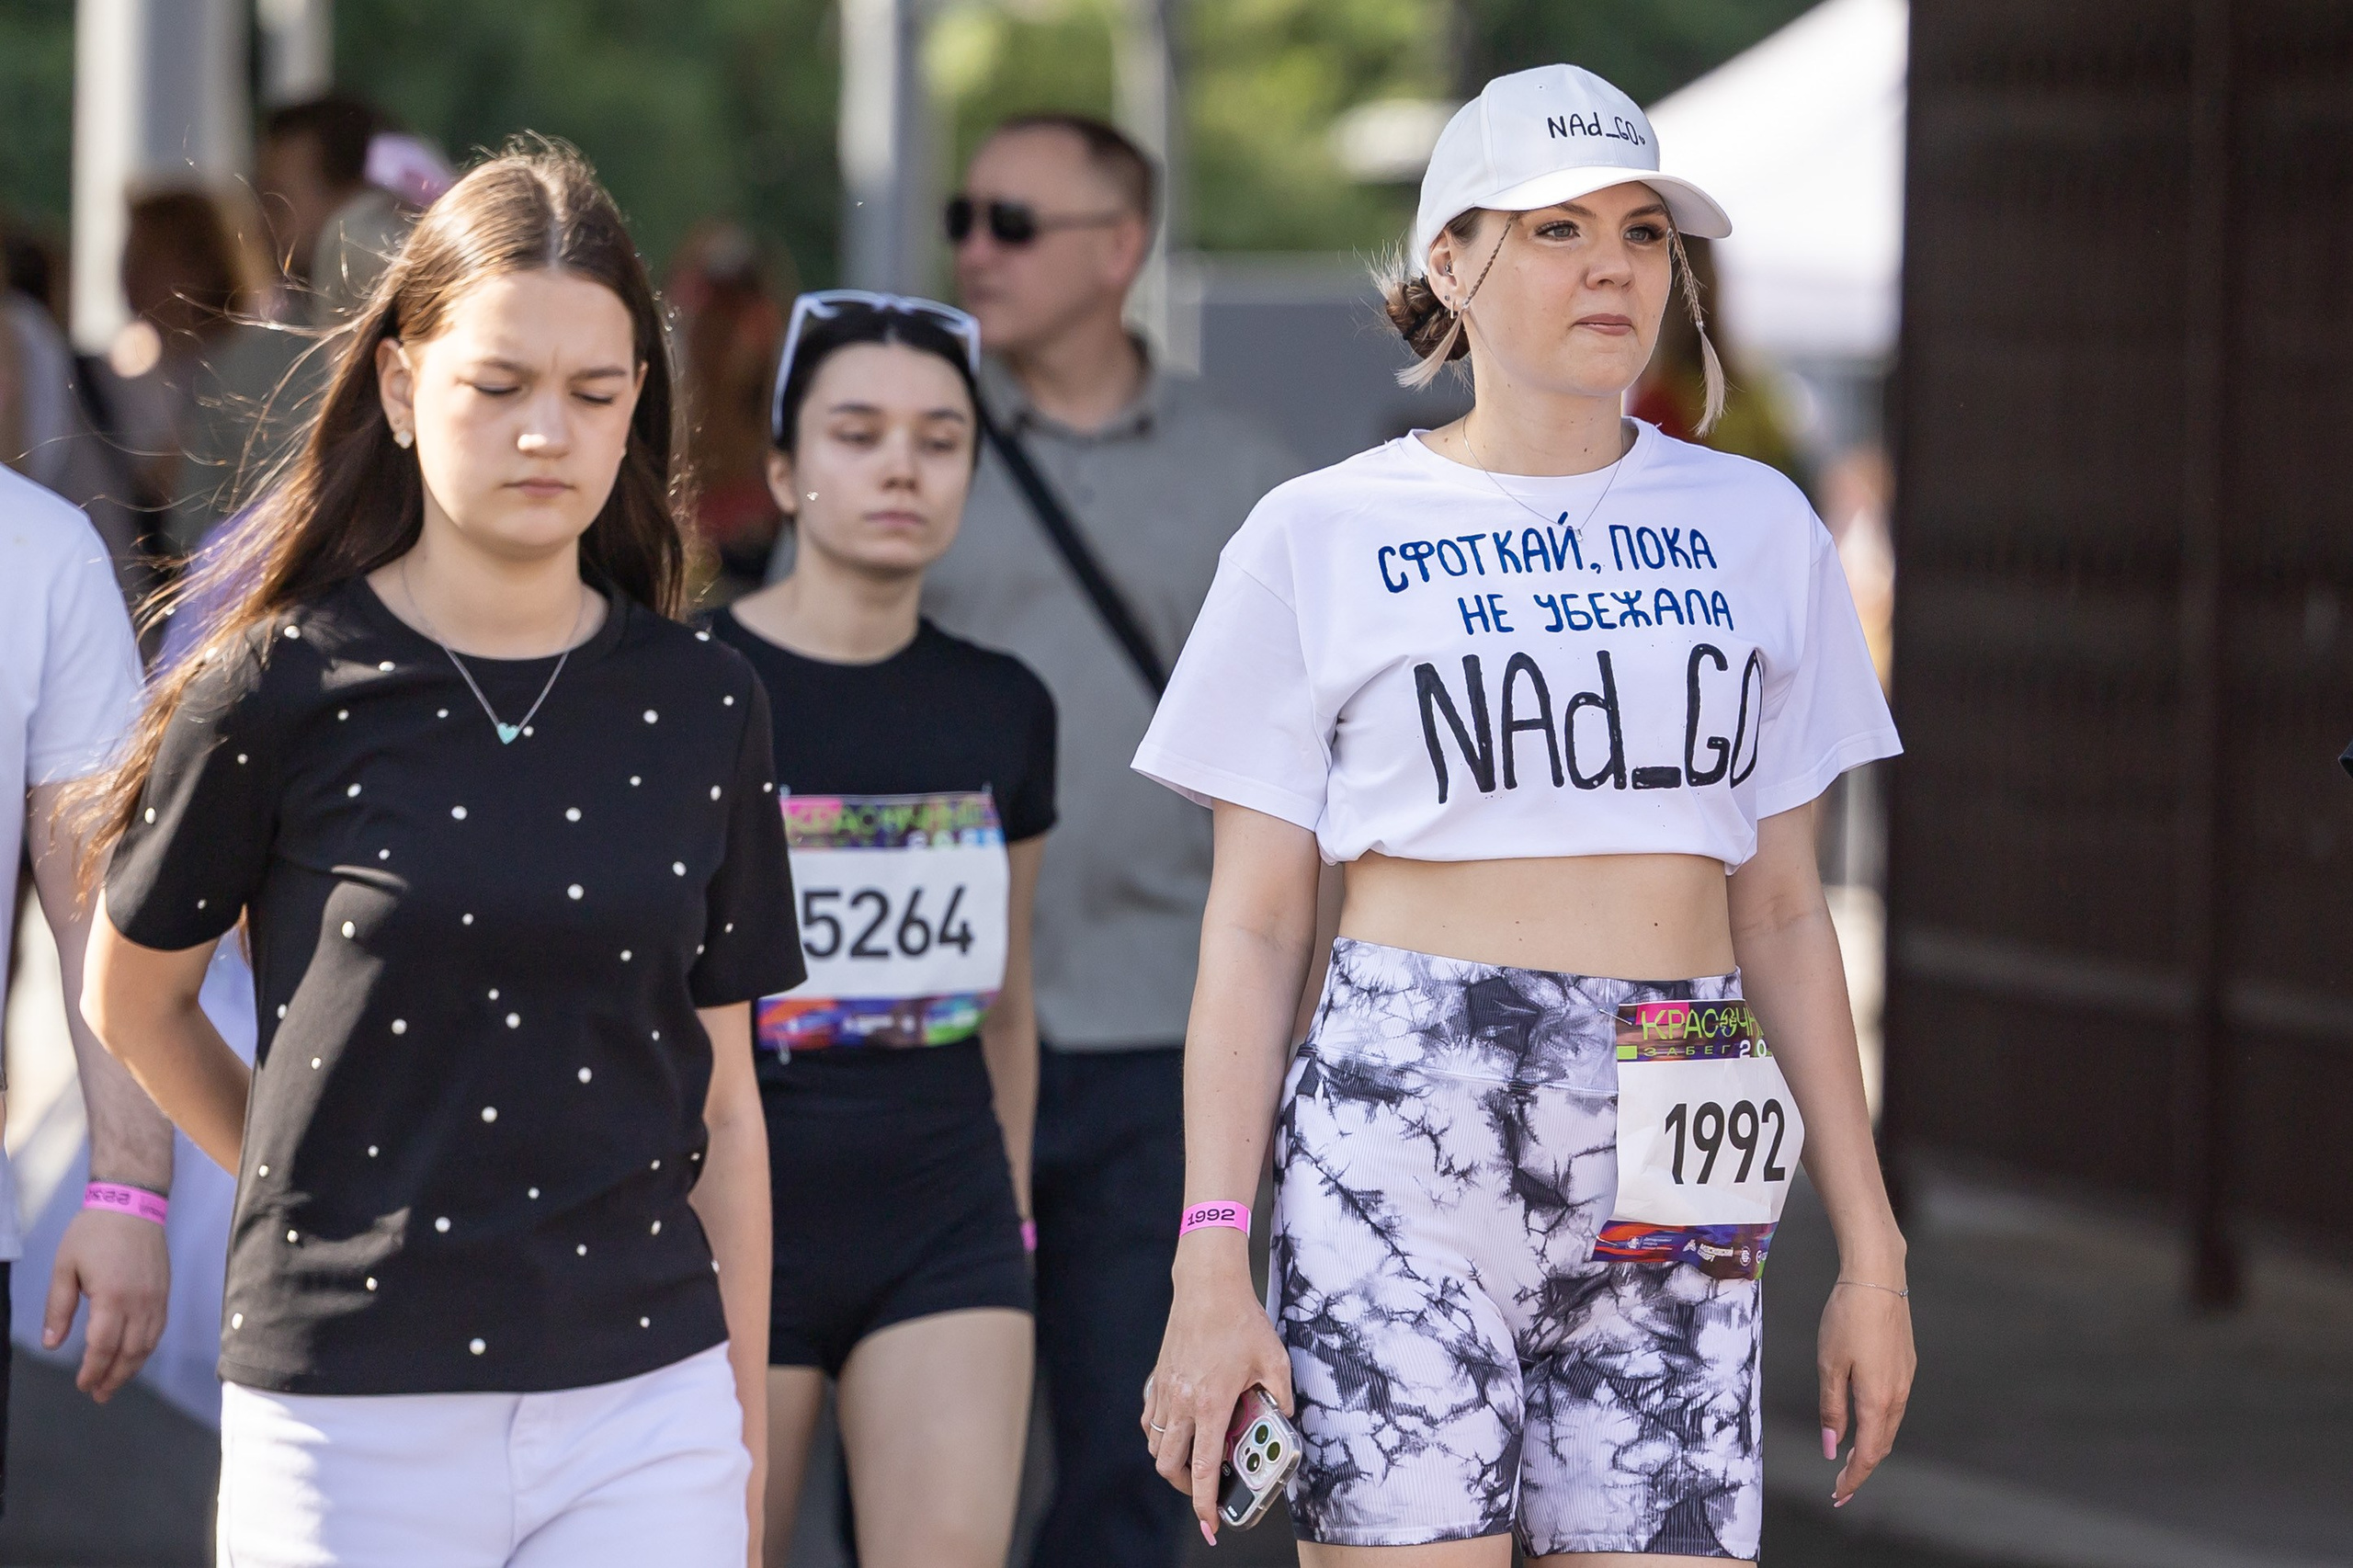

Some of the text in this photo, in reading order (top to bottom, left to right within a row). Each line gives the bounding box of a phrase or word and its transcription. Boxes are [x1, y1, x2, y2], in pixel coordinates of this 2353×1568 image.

[1608, 524, 1718, 571] ПОКА
[1458, 588, 1734, 635] НЕ УБЕЖАЛА
[801, 884, 975, 959] 5264
[1665, 1098, 1786, 1185] 1992
[1187, 1209, 1236, 1226] 1992
